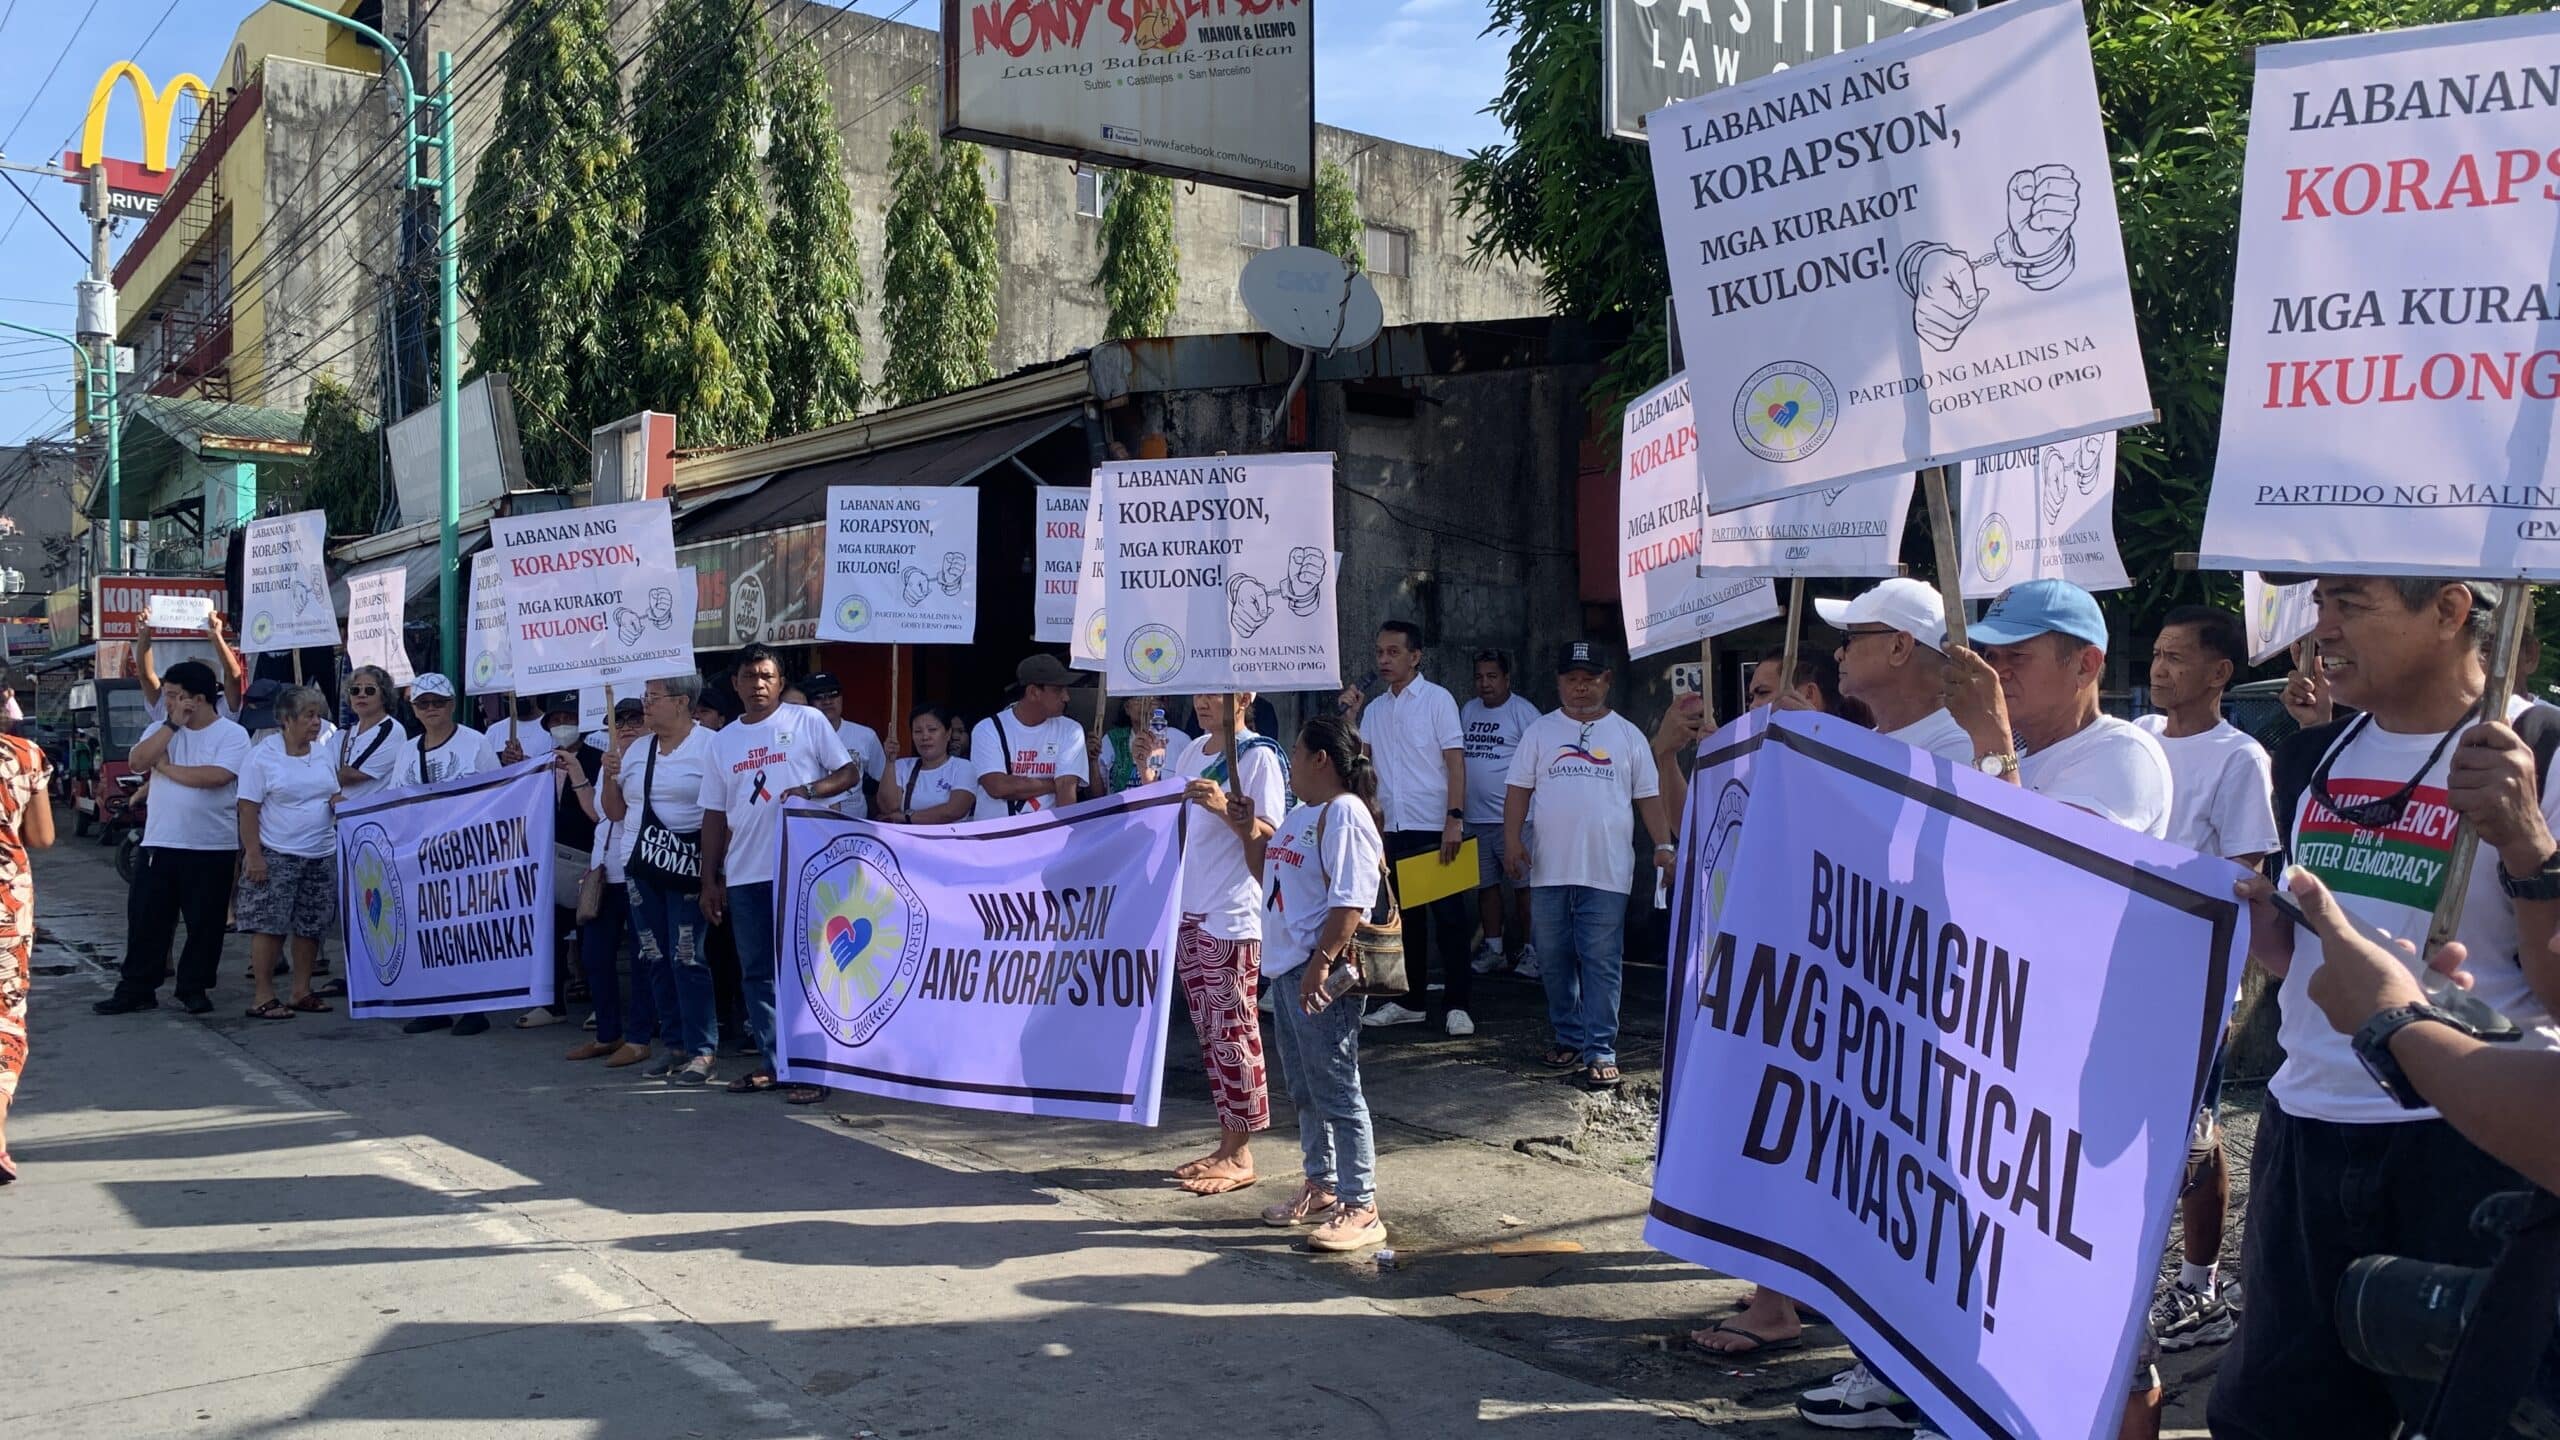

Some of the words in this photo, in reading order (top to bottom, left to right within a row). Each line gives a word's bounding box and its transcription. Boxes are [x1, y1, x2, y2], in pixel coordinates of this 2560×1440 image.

[1198, 24, 1242, 44] MANOK
[1243, 24, 1253, 41] &
[1254, 20, 1297, 40] LIEMPO
[1000, 59, 1094, 80] Lasang
[1102, 43, 1294, 72] Babalik-Balikan
[1651, 29, 1740, 86] LAW
[1083, 77, 1112, 91] Subic
[1188, 68, 1208, 81] San
[1681, 83, 1833, 152] LABANAN
[1841, 60, 1911, 107] ANG
[2289, 64, 2560, 132] LABANAN
[1689, 103, 1961, 211] KORAPSYON,
[1700, 226, 1768, 266] MGA
[1774, 183, 1919, 246] KURAKOT
[1707, 237, 1891, 318] IKULONG!
[2267, 289, 2386, 335] MGA
[2398, 280, 2560, 327] KURA
[1849, 373, 1934, 407] PARTIDO
[1937, 359, 1968, 387] NG
[1973, 342, 2060, 378] MALINIS
[2063, 334, 2097, 355] NA
[1928, 376, 2043, 416] GOBYERNO
[2048, 363, 2103, 390] (PMG)
[1118, 468, 1205, 489] LABANAN
[1208, 466, 1247, 485] ANG
[840, 499, 893, 512] LABANAN
[895, 499, 921, 512] ANG
[2255, 484, 2385, 505] PARTIDO
[2394, 484, 2439, 505] NG
[2447, 483, 2560, 507] MALIN
[1118, 496, 1270, 526] KORAPSYON,
[504, 524, 580, 547] LABANAN
[583, 519, 617, 537] ANG
[839, 519, 934, 537] KORAPSYON,
[1627, 510, 1657, 540] MGA
[1765, 523, 1810, 538] MALINIS
[1811, 523, 1826, 537] NA
[511, 544, 641, 577] KORAPSYON,
[837, 544, 863, 555] MGA
[864, 543, 917, 556] KURAKOT
[1119, 542, 1159, 558] MGA
[1162, 539, 1244, 556] KURAKOT
[836, 559, 901, 575] IKULONG!
[1044, 560, 1073, 572] MGA
[1120, 564, 1222, 590] IKULONG!
[518, 600, 552, 616] MGA
[554, 590, 623, 611] KURAKOT
[874, 611, 907, 620] PARTIDO
[520, 611, 609, 641] IKULONG!
[1190, 648, 1238, 659] PARTIDO
[1240, 647, 1258, 657] NG
[1260, 646, 1308, 657] MALINIS
[1309, 645, 1325, 655] NA
[528, 662, 565, 675] PARTIDO
[1232, 661, 1295, 673] GOBYERNO
[1296, 660, 1326, 672] (PMG)
[1469, 721, 1500, 733] STOP
[732, 751, 787, 774] CORRUPTION!
[748, 746, 769, 759] STOP
[1016, 750, 1038, 762] STOP
[1594, 767, 1615, 777] 2016
[417, 816, 530, 876] PAGBAYARIN
[2351, 828, 2372, 846] FOR
[2375, 831, 2385, 848] A
[2298, 842, 2343, 869] BETTER
[2343, 846, 2443, 888] DEMOCRACY
[418, 878, 451, 923] ANG
[455, 867, 510, 917] LAHAT
[968, 885, 1118, 942] WAKASAN
[1807, 849, 2030, 1074] BUWAGIN
[918, 947, 981, 1001] ANG
[982, 948, 1160, 1008] KORAPSYON
[1699, 931, 1830, 1061] ANG
[1836, 984, 2094, 1262] POLITICAL
[1741, 1063, 2007, 1335] DYNASTY!
